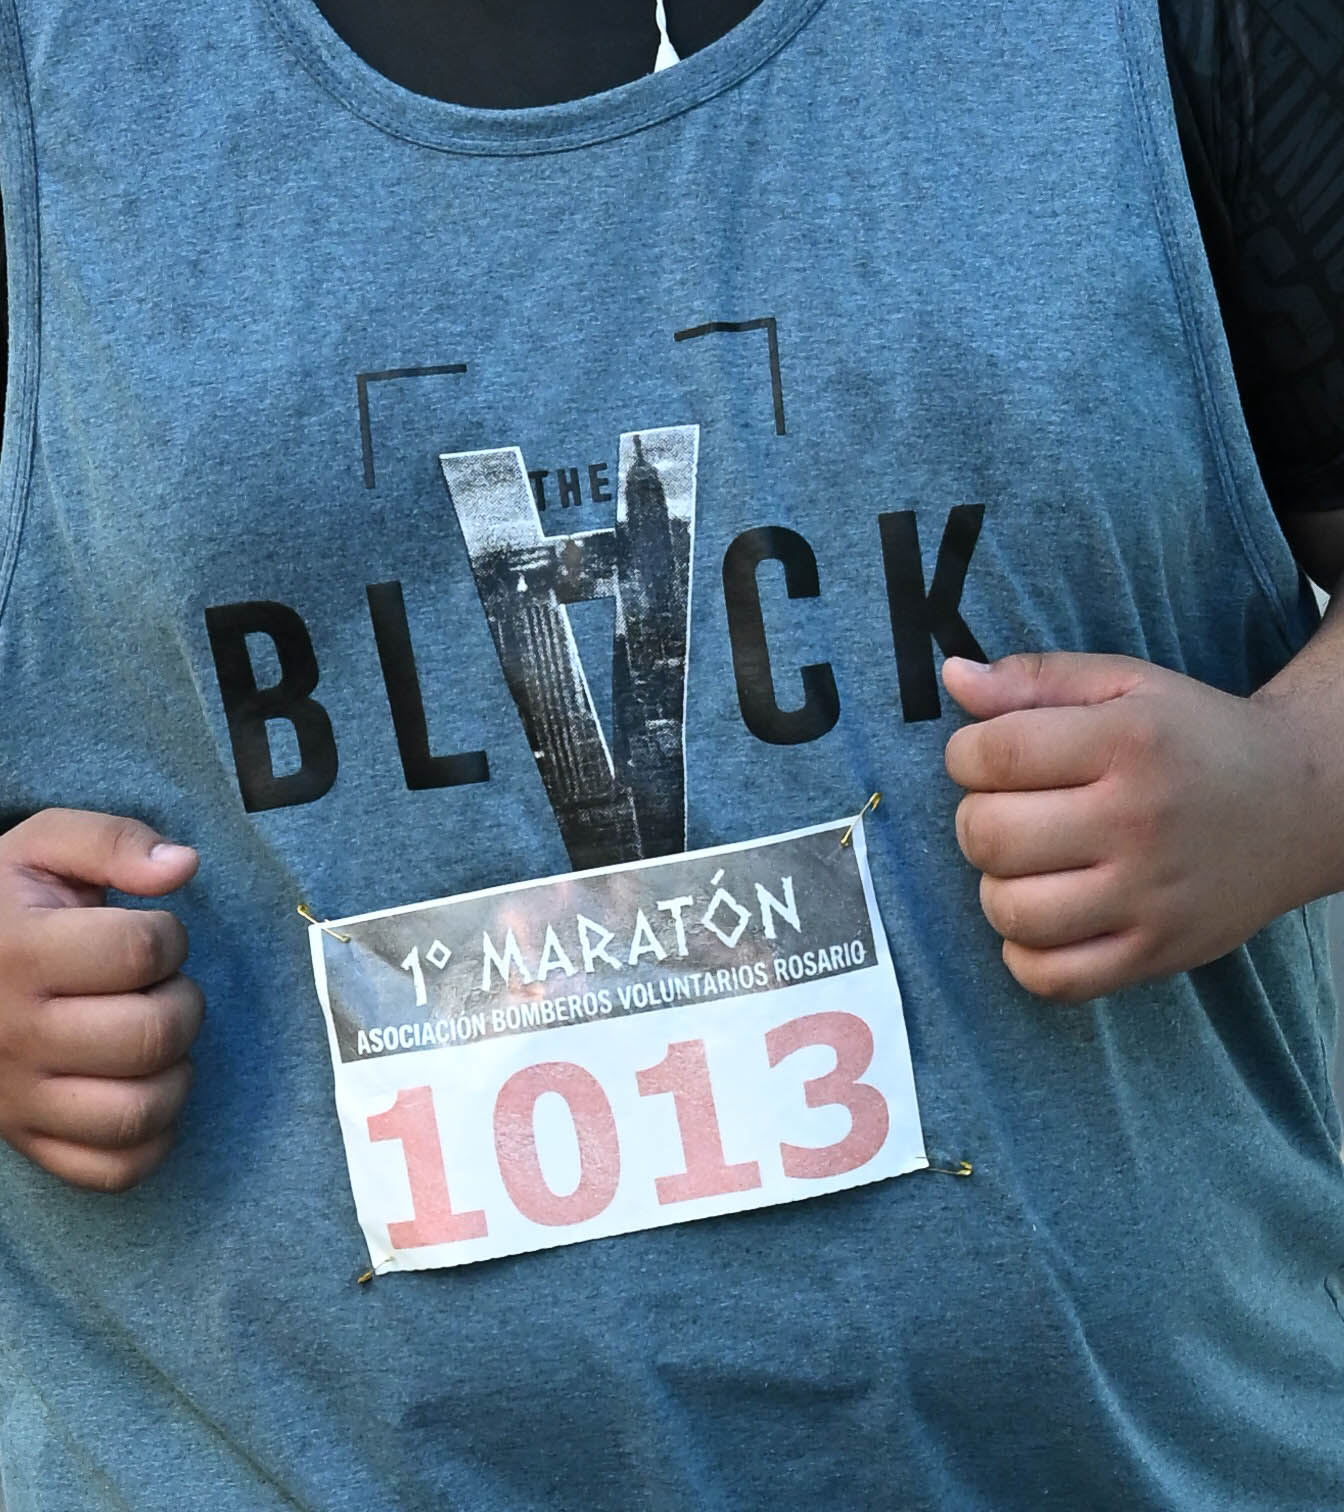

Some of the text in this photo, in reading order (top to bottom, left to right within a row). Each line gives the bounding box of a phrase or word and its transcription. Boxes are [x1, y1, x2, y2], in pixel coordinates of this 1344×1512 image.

[528, 462, 613, 512] THE
[481, 867, 802, 992] MARATÓN
[356, 938, 867, 1056] ASOCIACIÓN BOMBEROS VOLUNTARIOS ROSARIO
[366, 1010, 891, 1251] 1013
